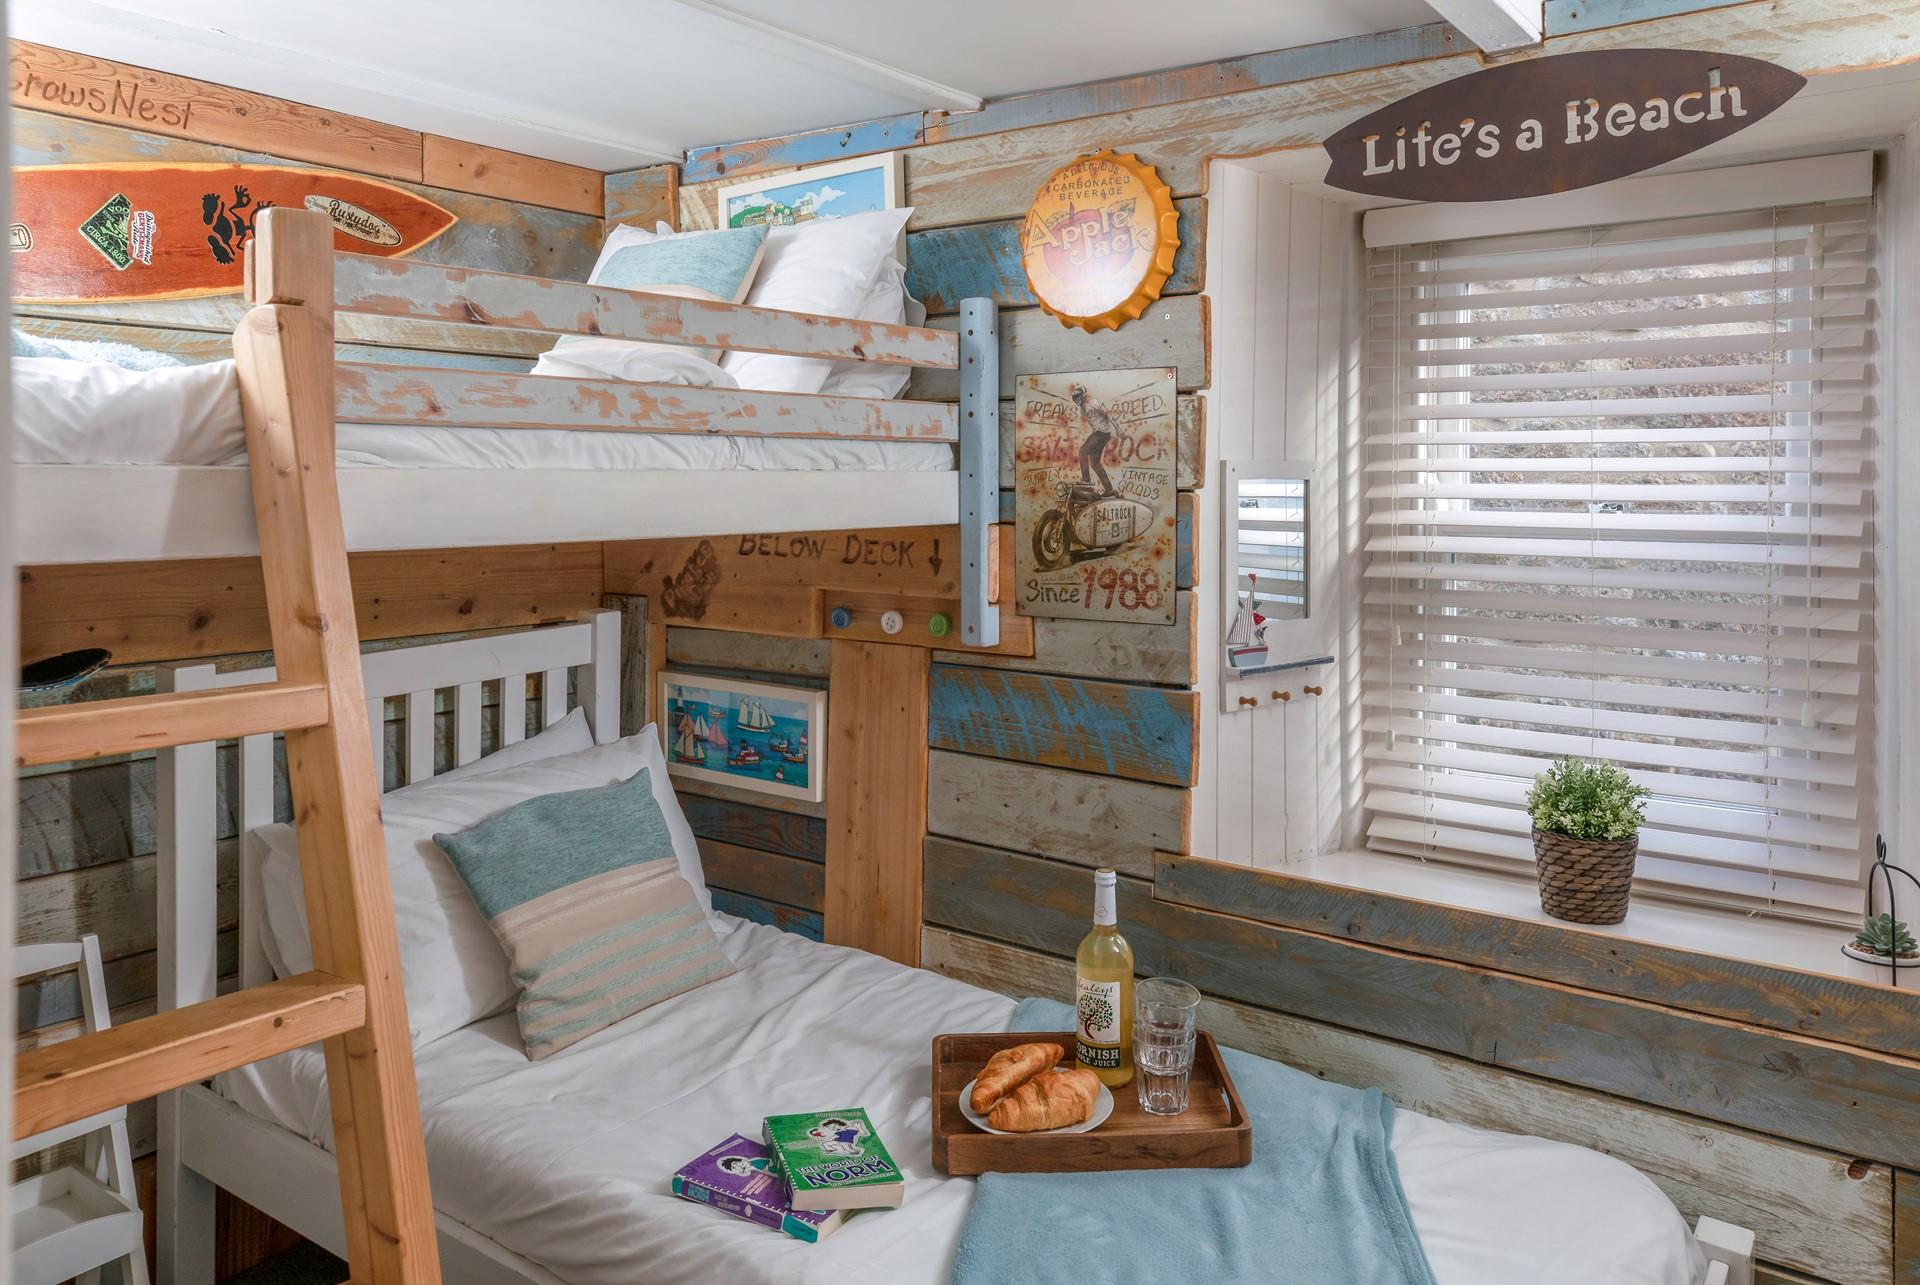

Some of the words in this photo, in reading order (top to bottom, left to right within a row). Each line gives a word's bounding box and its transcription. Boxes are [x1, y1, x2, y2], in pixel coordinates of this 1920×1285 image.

[111, 79, 196, 130] Nest
[1362, 118, 1500, 177] Life's
[1515, 118, 1543, 152] a
[1564, 66, 1748, 145] Beach
[1070, 161, 1121, 176] DELICIOUS
[1053, 175, 1131, 192] CARBONATED
[1059, 187, 1124, 201] BEVERAGE
[1024, 206, 1131, 257] Apple
[86, 225, 109, 248] CIRCA
[108, 246, 127, 264] 1800
[1025, 400, 1079, 422] FREAKS
[1121, 469, 1168, 485] VINTAGE
[1097, 506, 1132, 522] SALTROCK
[737, 534, 826, 559] BELOW
[841, 534, 914, 568] DECK
[1026, 578, 1081, 603] Since
[1081, 566, 1161, 611] 1988
[1077, 1043, 1120, 1060] ORNISH
[1093, 1059, 1116, 1067] JUICE
[802, 1158, 893, 1188] NORM
[820, 1158, 862, 1171] WORLD
